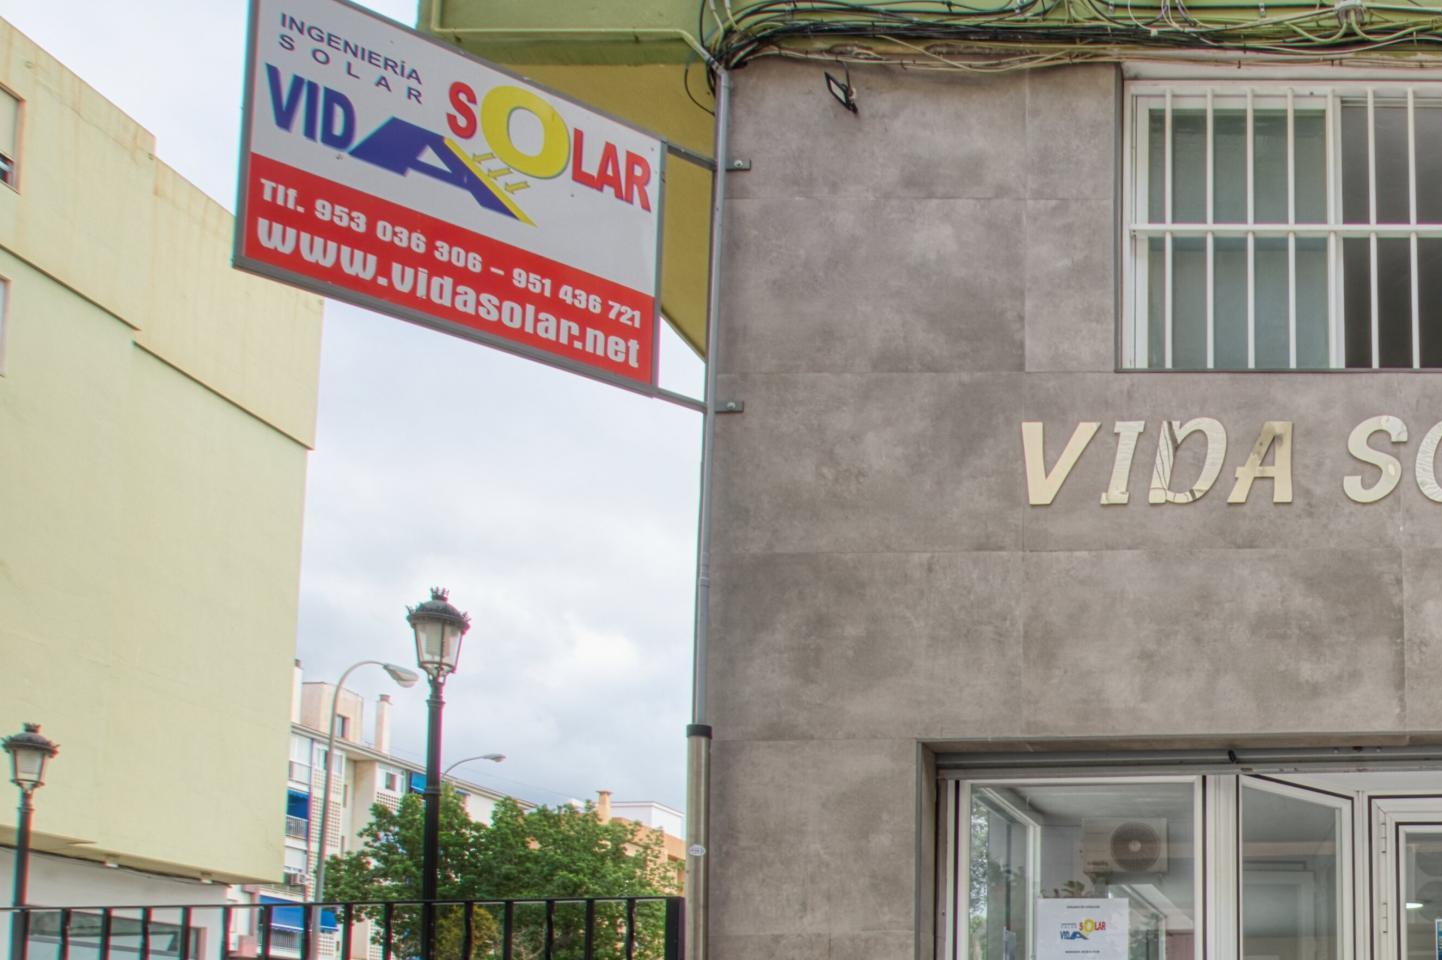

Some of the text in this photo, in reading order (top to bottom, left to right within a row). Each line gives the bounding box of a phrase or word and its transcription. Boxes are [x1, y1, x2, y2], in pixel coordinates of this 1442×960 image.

[265, 62, 528, 224] VIDA
[446, 81, 651, 213] SOLAR
[257, 217, 640, 369] www.vidasolar.net
[260, 178, 305, 213] Tlf.
[315, 198, 367, 234] 953
[376, 219, 427, 254] 036
[434, 237, 482, 274] 306
[512, 267, 552, 299] 951
[558, 284, 602, 316] 436
[608, 300, 642, 329] 721
[1021, 417, 1294, 506] VIDA
[1079, 918, 1106, 933] SOLAR
